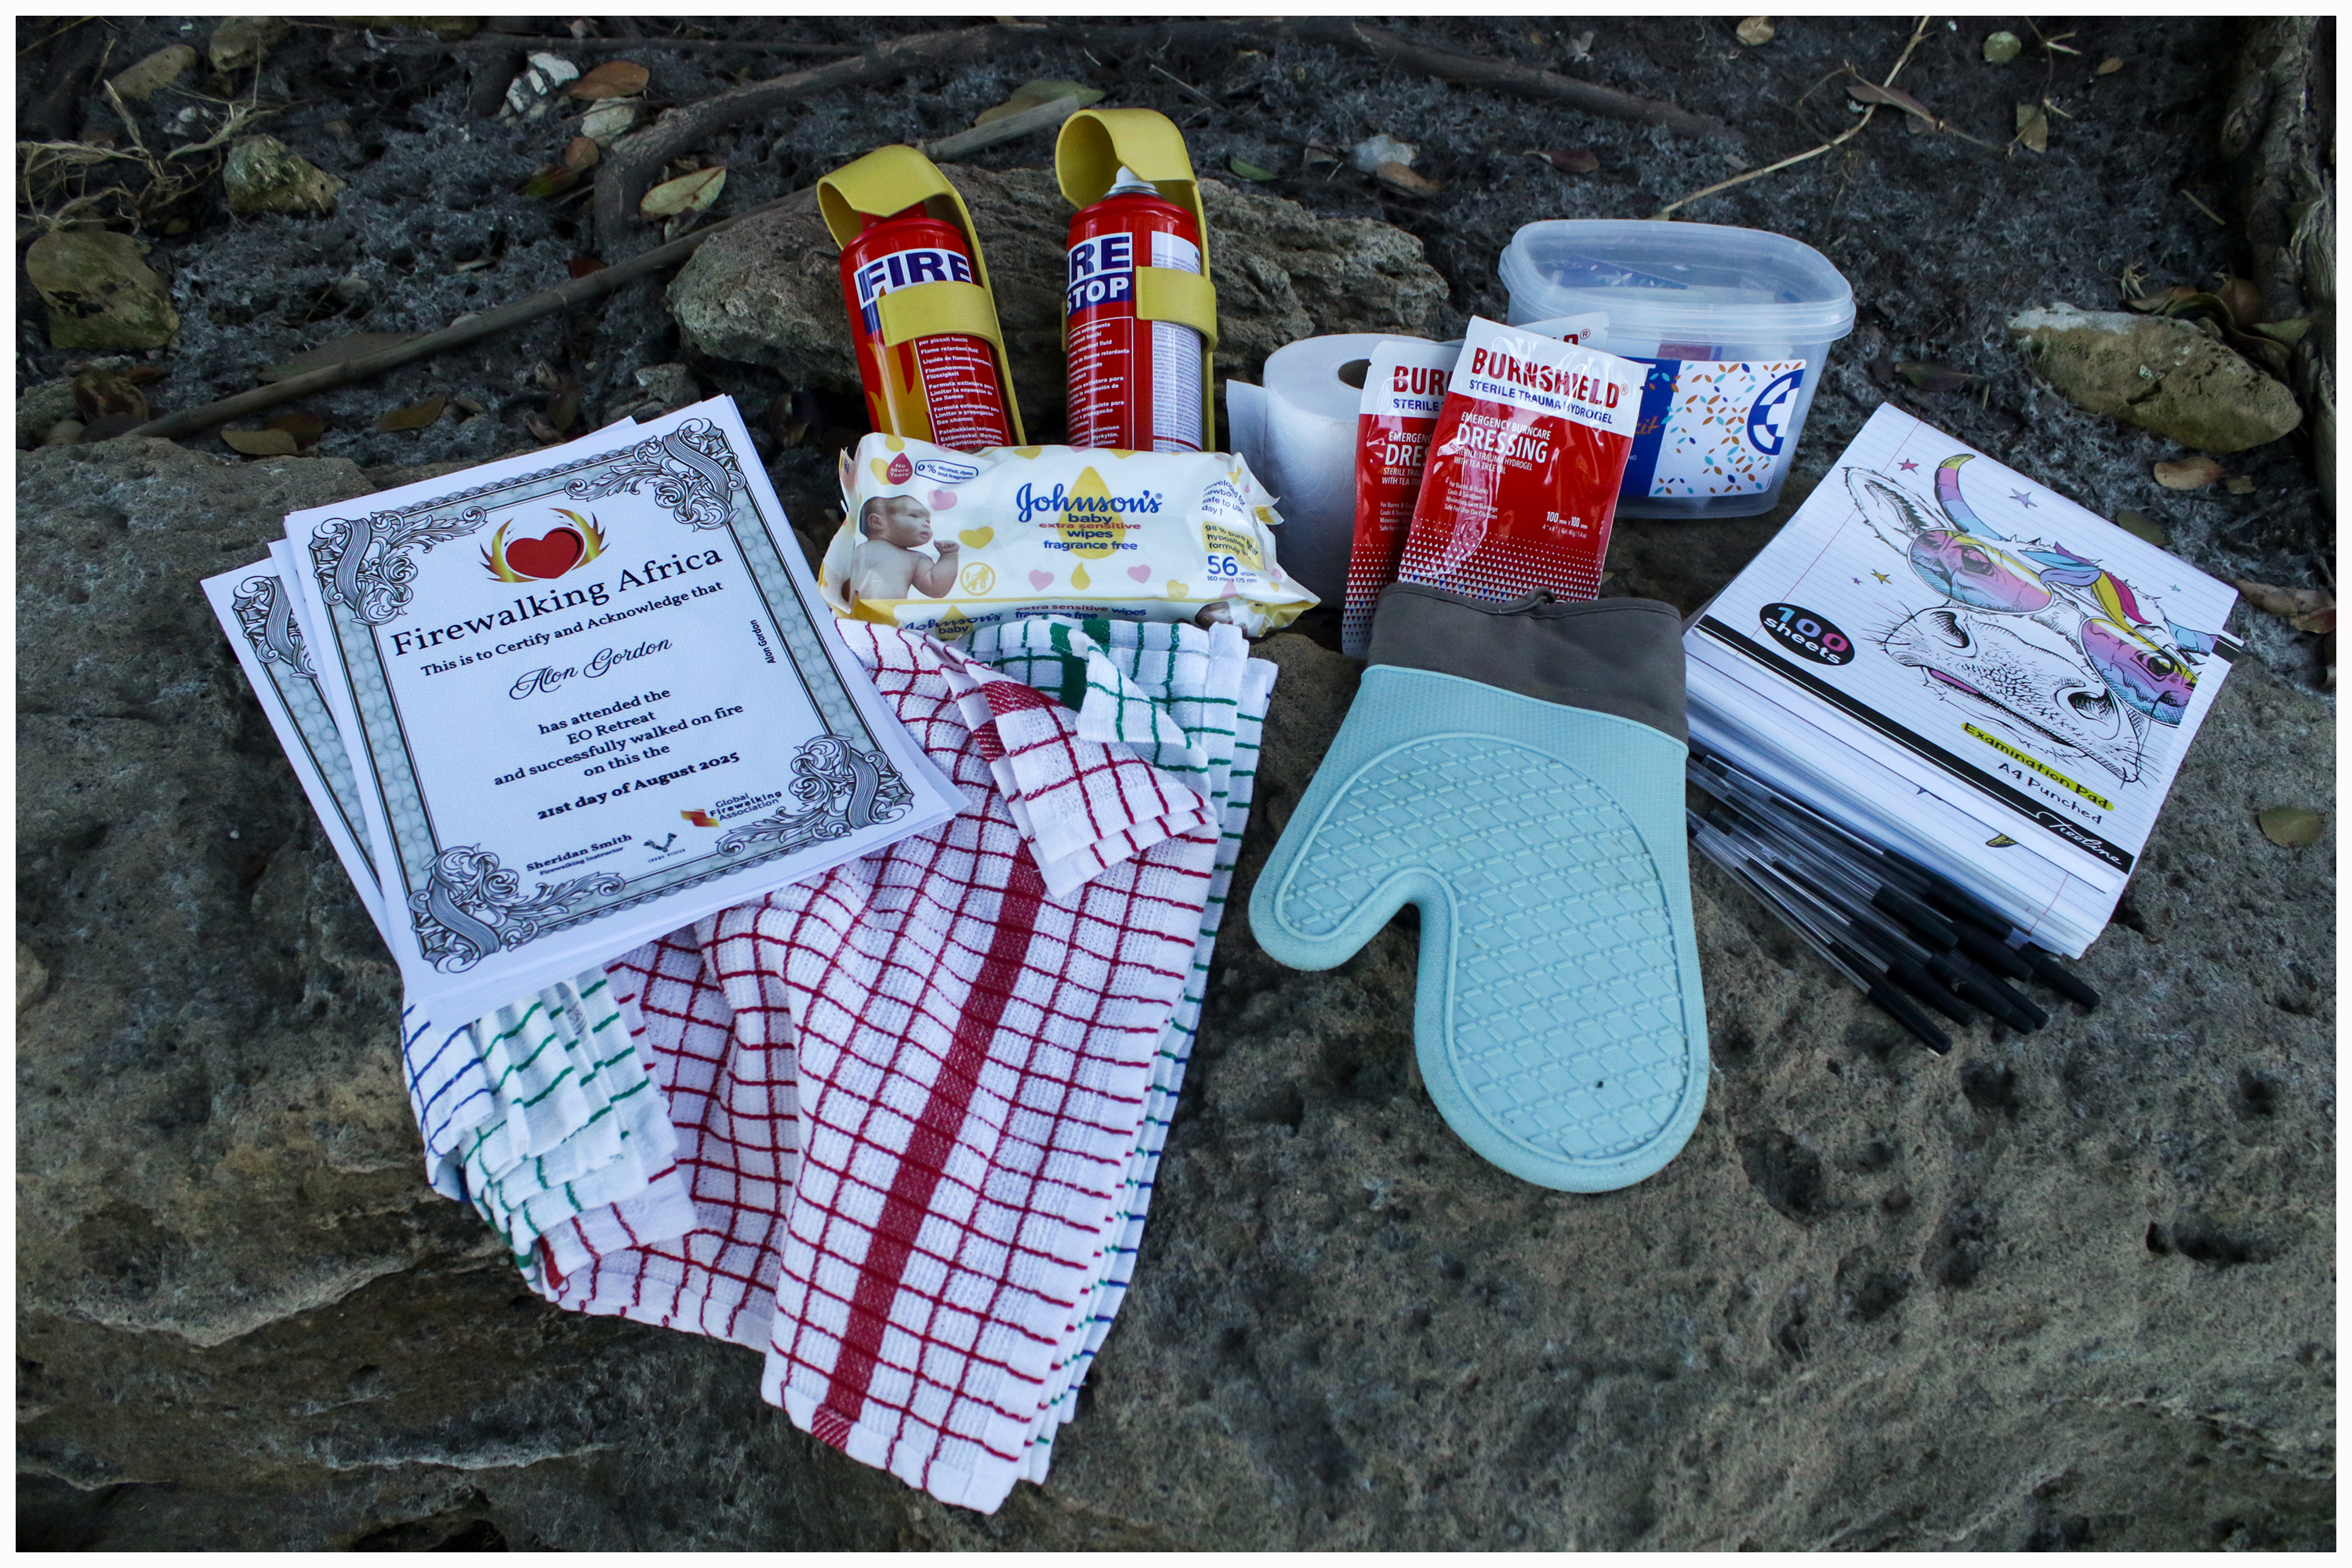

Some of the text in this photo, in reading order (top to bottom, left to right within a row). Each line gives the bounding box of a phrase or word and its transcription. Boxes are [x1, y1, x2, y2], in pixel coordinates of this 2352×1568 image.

[858, 252, 971, 303] FIRE
[1393, 398, 1439, 412] STERILE
[1470, 379, 1612, 424] STERILE TRAUMA HYDROGEL
[1388, 431, 1433, 444] EMERGENC
[1461, 412, 1551, 441] EMERGENCY BURNCARE
[1456, 447, 1533, 470] STERILE TRAUMA HYDROGEL
[1457, 423, 1548, 463] DRESSING
[927, 465, 937, 474] %
[938, 466, 960, 474] alcohol,
[1383, 467, 1406, 476] STERILE
[1454, 456, 1468, 466] WITH
[1482, 461, 1496, 470] TREE
[1497, 465, 1506, 474] OIL
[1069, 514, 1112, 524] baby
[1202, 505, 1218, 514] day
[1547, 511, 1559, 523] 100
[1571, 517, 1580, 527] 100
[1044, 540, 1138, 552] fragrance free
[1067, 529, 1113, 539] wipes
[1207, 555, 1238, 576] 56
[390, 549, 723, 656] Firewalking Africa
[420, 581, 724, 677] This is to Certify and Acknowledge that
[750, 619, 776, 663] Alon Gordon
[1763, 618, 1841, 664] sheets
[1778, 607, 1848, 652] 100
[509, 638, 673, 700] Alon Gordon
[538, 688, 671, 735] has attended the
[567, 710, 656, 745] EO Retreat
[494, 703, 743, 786] and successfully walked on fire
[583, 744, 670, 778] on this the
[1964, 723, 2108, 809] Examination Pad
[537, 751, 741, 820] 21st day of August 2025
[715, 793, 750, 808] Global
[1998, 763, 2102, 824] A4 Punched
[710, 790, 782, 818] Firewalking
[719, 798, 779, 821] Association
[526, 833, 633, 872] Sheridan Smith
[2036, 811, 2122, 866] Treeline
[539, 846, 624, 876] Firewalking Instructor
